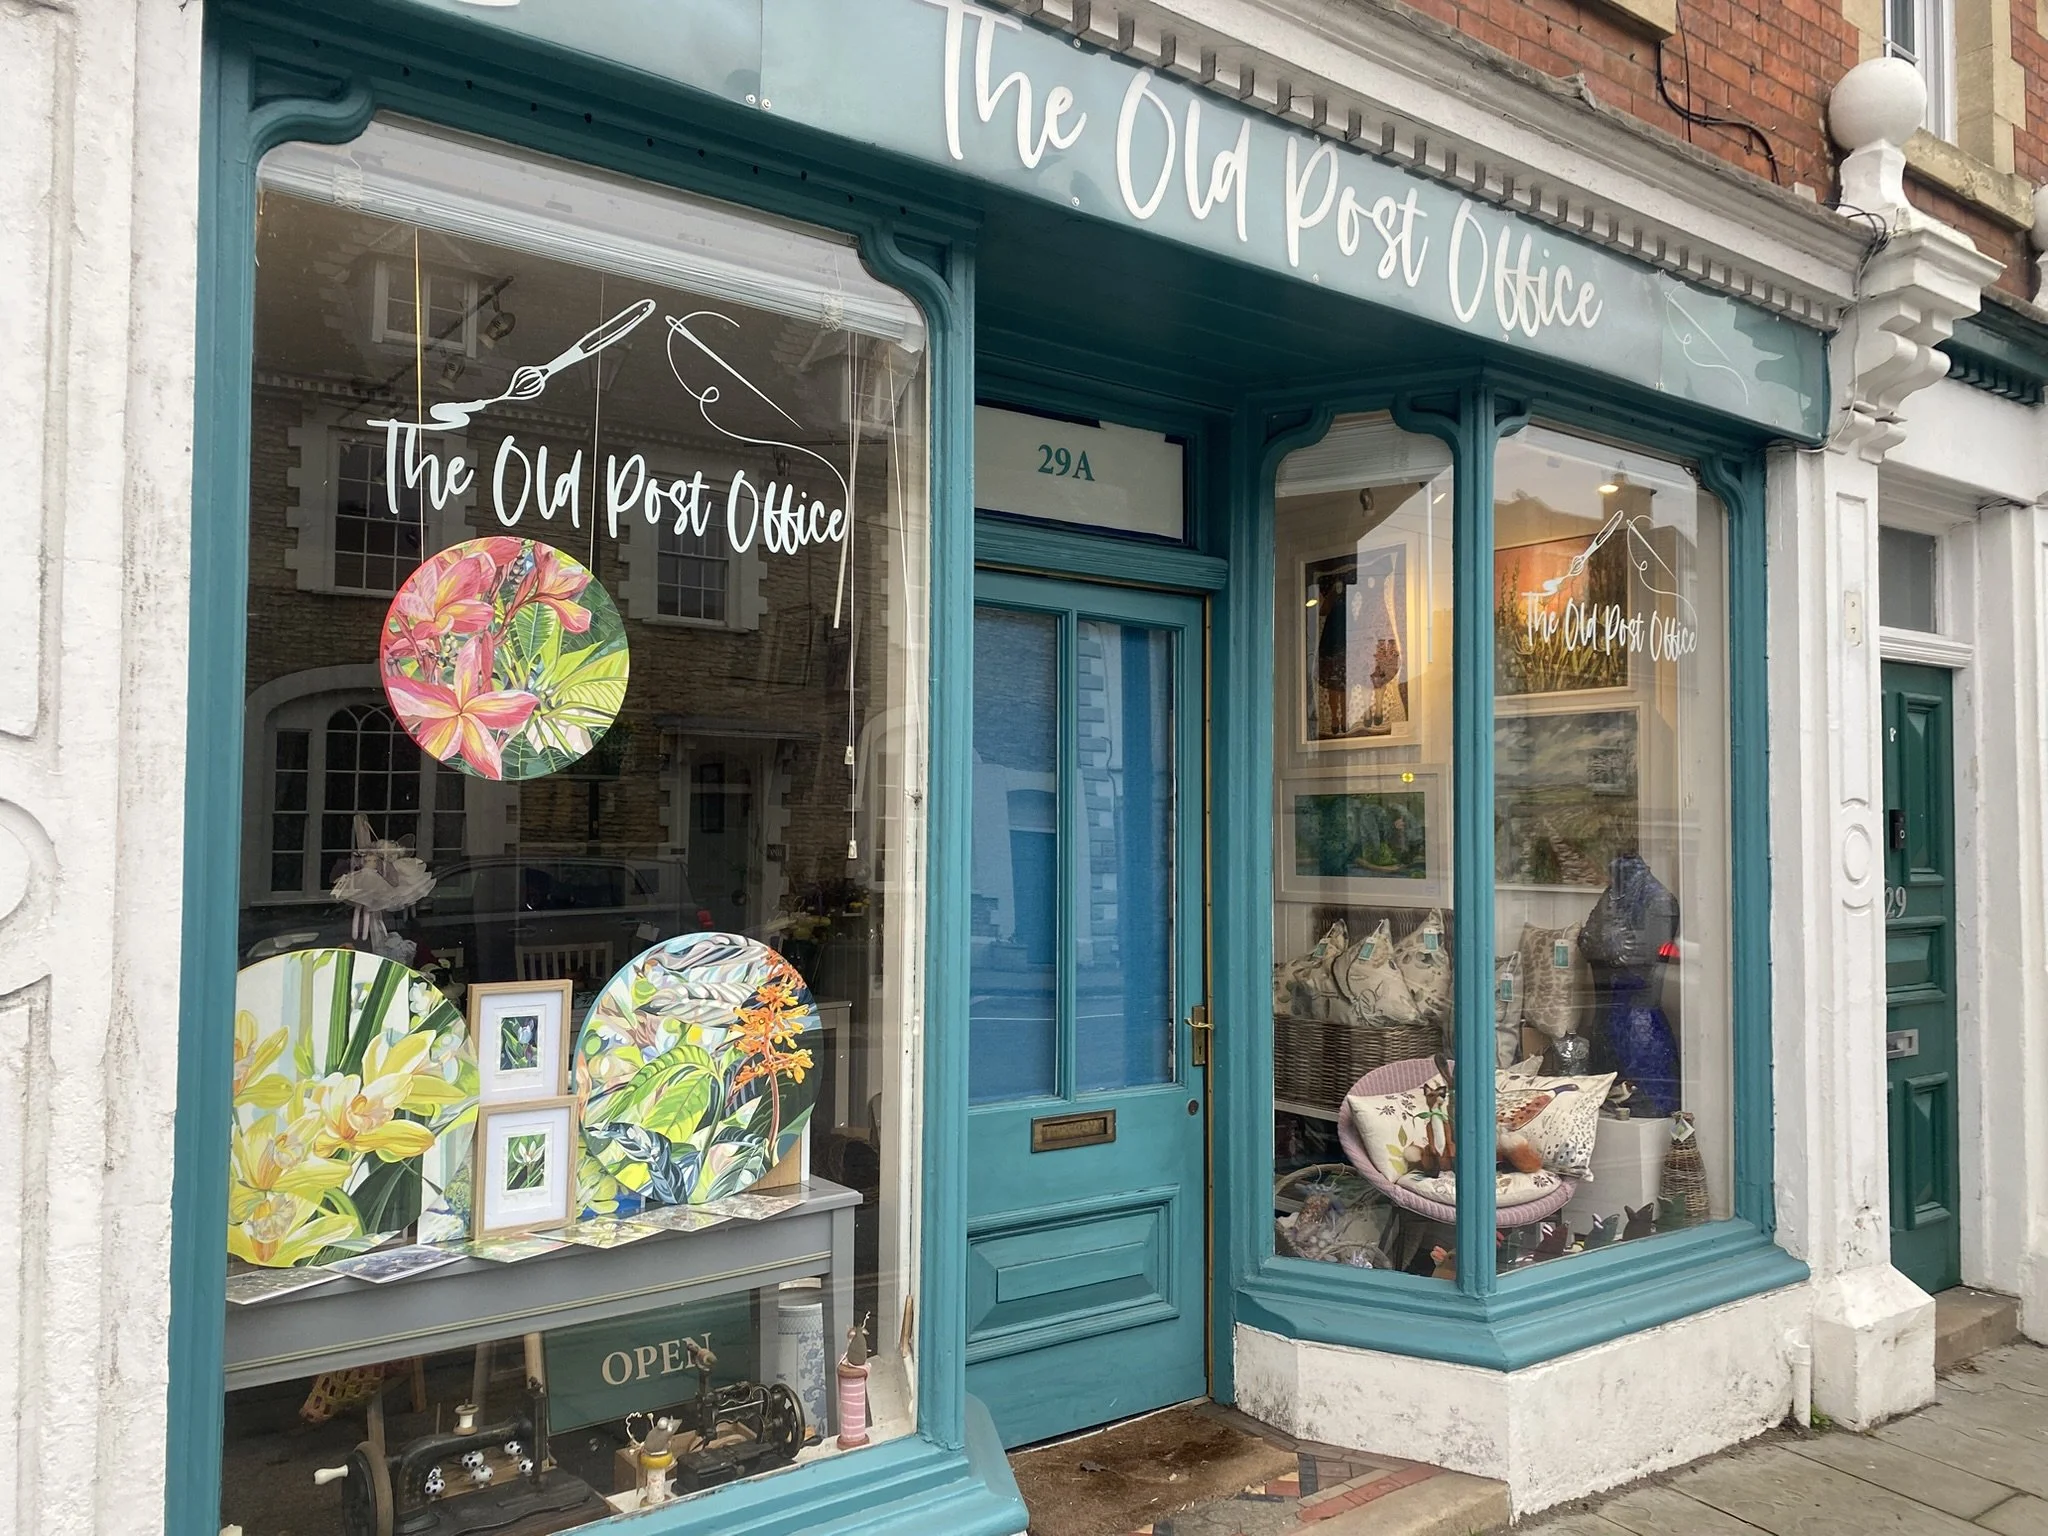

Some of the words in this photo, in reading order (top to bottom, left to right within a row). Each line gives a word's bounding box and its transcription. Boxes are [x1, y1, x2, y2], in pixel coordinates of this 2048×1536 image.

[921, 0, 1087, 169] The
[1116, 70, 1249, 242] Old
[1286, 136, 1430, 288] Post
[1449, 201, 1603, 338] Office
[366, 418, 474, 514] The
[493, 435, 582, 528] Old
[606, 453, 712, 538] Post
[727, 470, 847, 555] Office
[1037, 444, 1095, 482] 29A
[1521, 591, 1559, 646] The
[1564, 598, 1598, 651] Old
[1605, 603, 1645, 656] Post
[1650, 610, 1697, 662] Office
[1885, 886, 1907, 919] 29
[601, 1332, 712, 1385] OPEN
